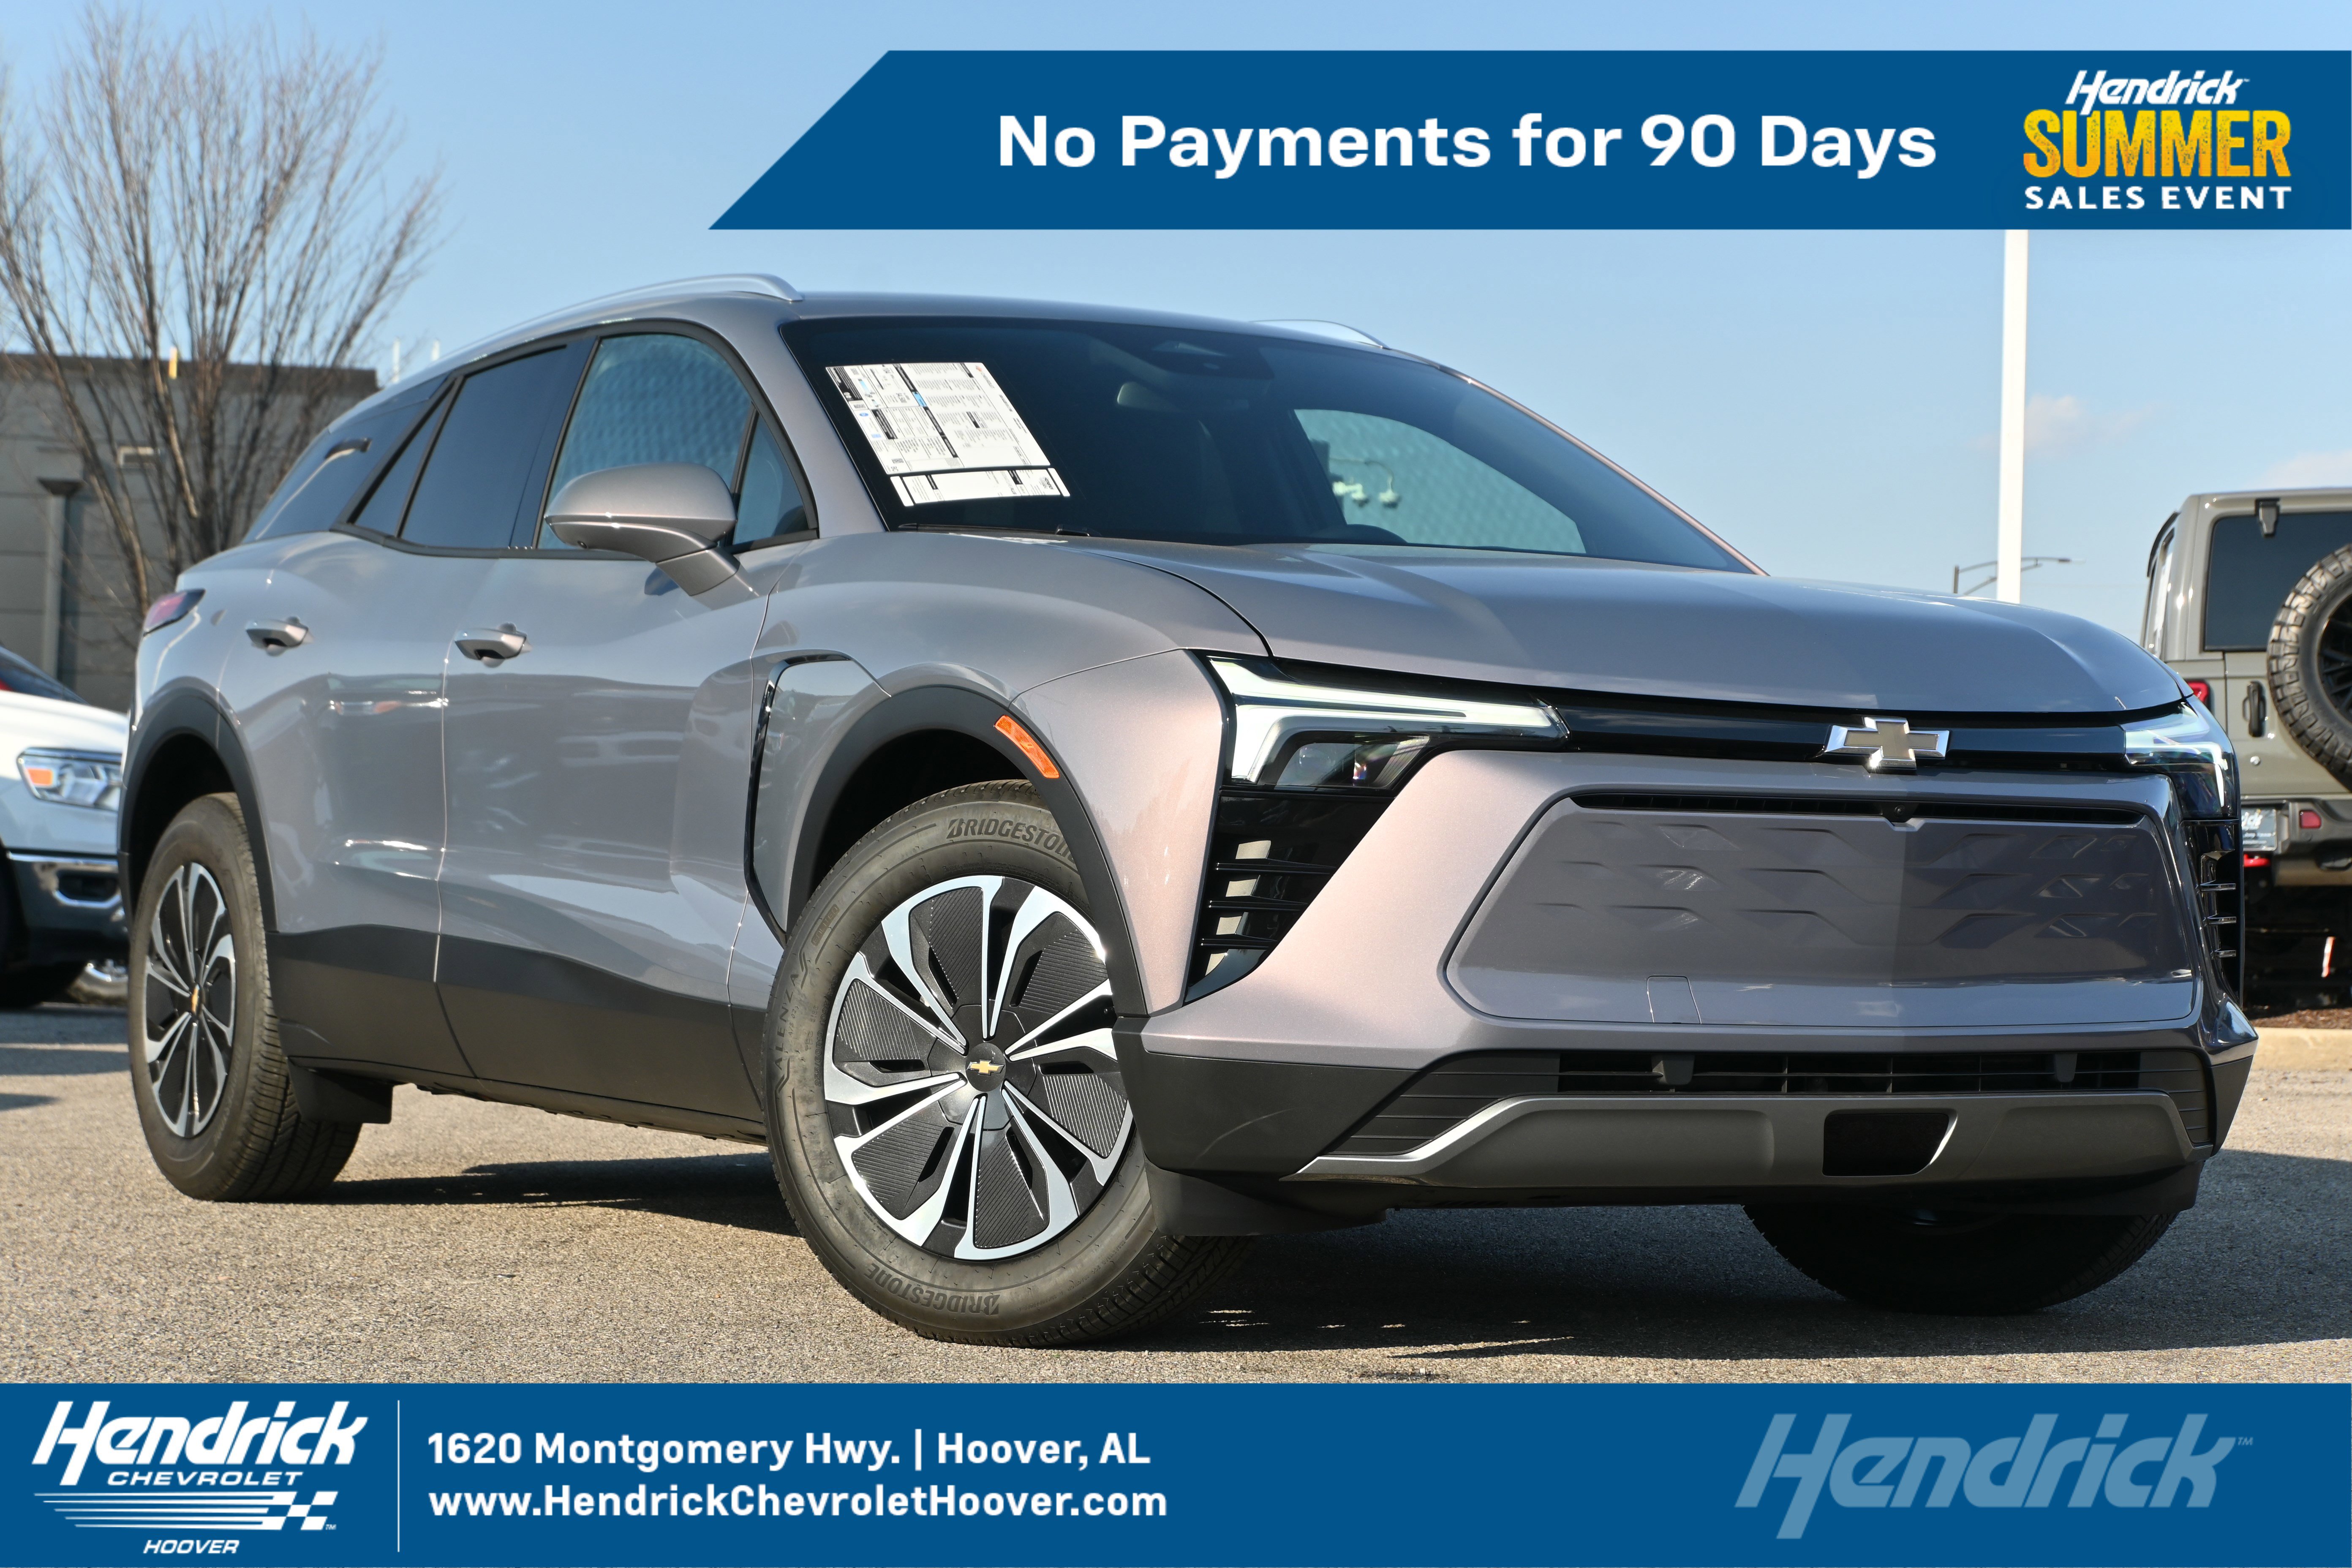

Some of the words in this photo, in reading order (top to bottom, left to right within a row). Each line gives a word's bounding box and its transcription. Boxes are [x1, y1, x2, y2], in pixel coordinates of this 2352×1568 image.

[946, 818, 1074, 863] BRIDGESTON
[774, 973, 799, 1071] ALENZA
[864, 1263, 1000, 1315] BRIDGESTONE
